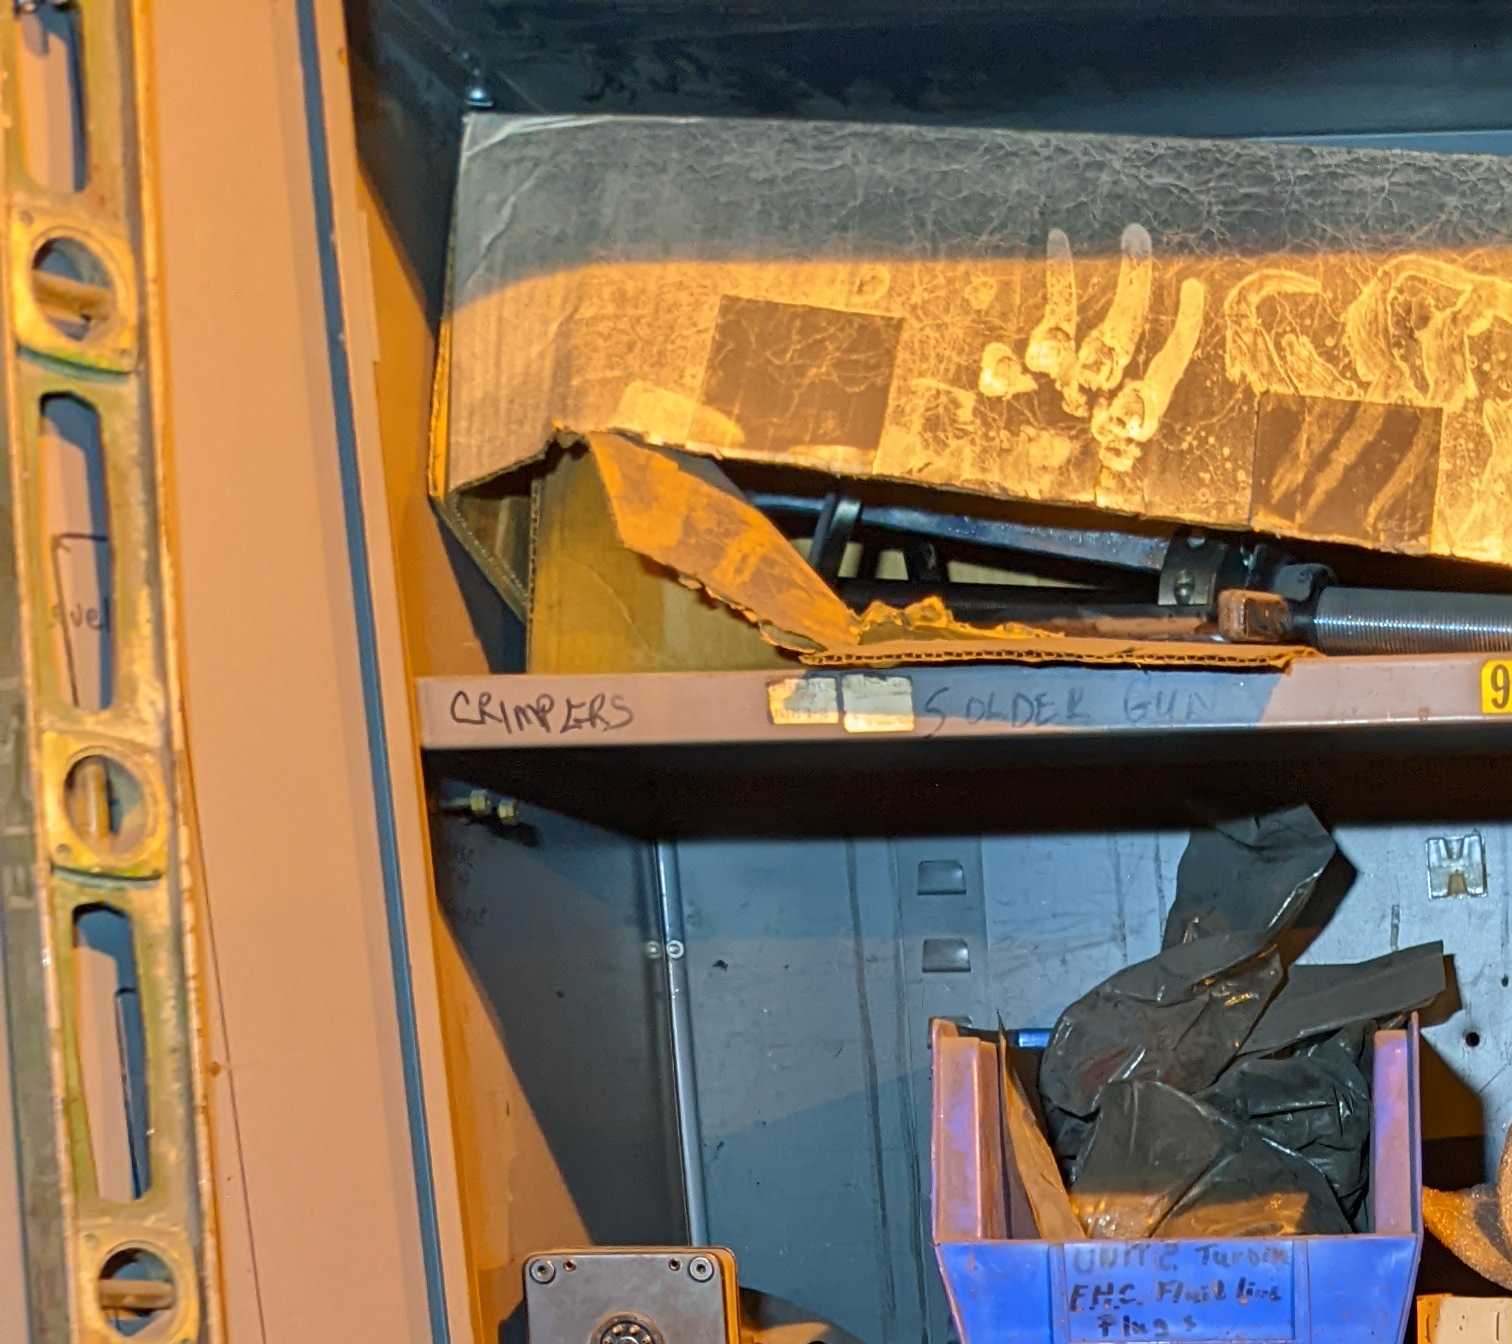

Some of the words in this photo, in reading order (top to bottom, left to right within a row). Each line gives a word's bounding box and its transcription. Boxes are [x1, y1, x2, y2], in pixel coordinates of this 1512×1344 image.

[1489, 666, 1512, 711] 9
[450, 690, 634, 735] CRIMPERS
[924, 685, 1090, 739] SOLDER
